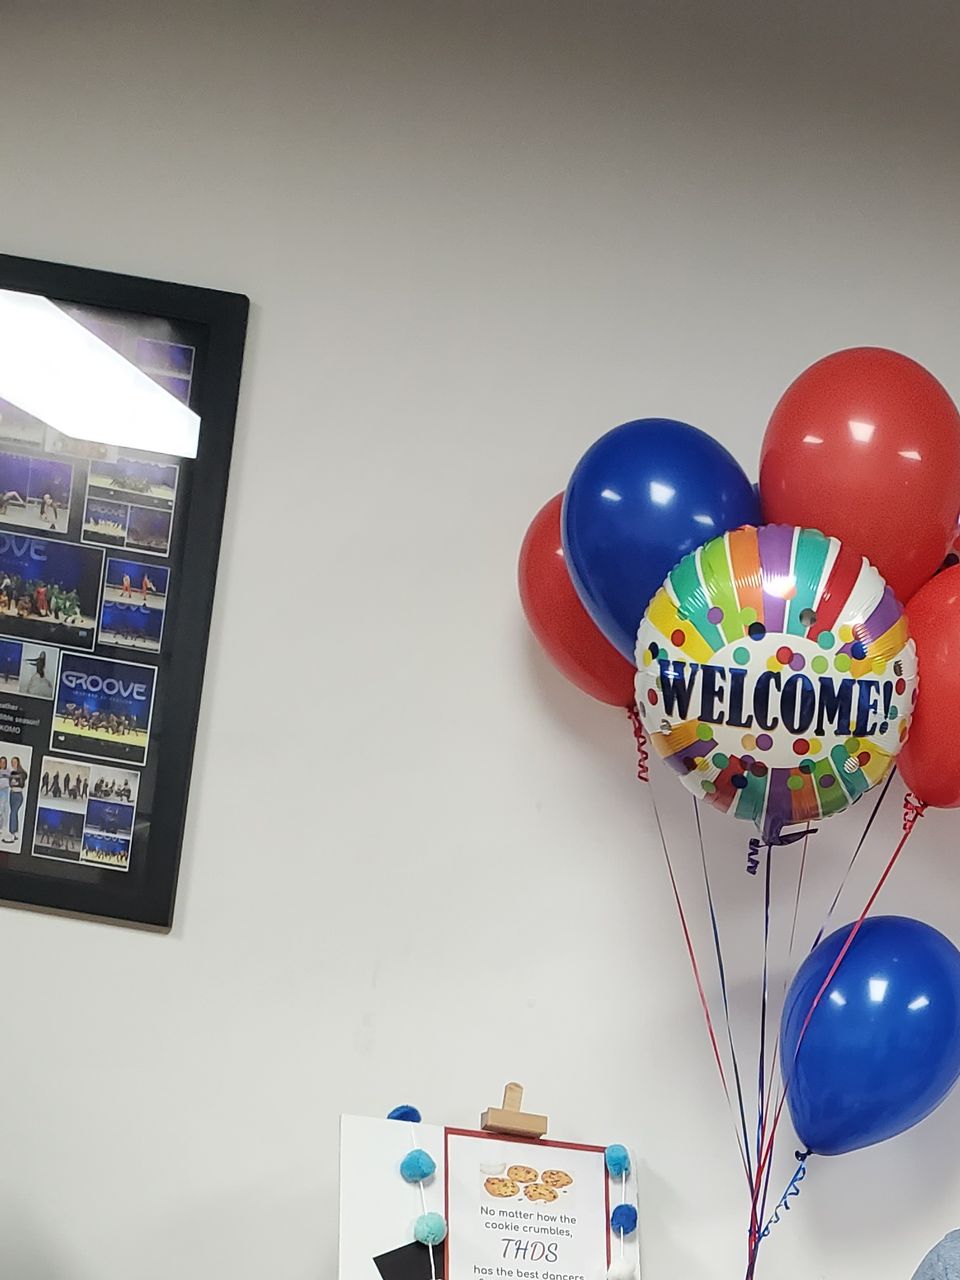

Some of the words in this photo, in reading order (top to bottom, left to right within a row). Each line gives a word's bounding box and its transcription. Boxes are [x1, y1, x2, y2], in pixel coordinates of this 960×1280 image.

[62, 670, 147, 700] GROOVE
[659, 658, 893, 737] WELCOME!
[480, 1206, 496, 1216] No
[499, 1210, 534, 1221] matter
[536, 1212, 558, 1222] how
[560, 1214, 577, 1225] the
[484, 1221, 519, 1231] cookie
[522, 1224, 573, 1238] crumbles,
[501, 1238, 558, 1263] THDS
[473, 1265, 493, 1275] has
[496, 1267, 513, 1277] the
[516, 1269, 539, 1279] best
